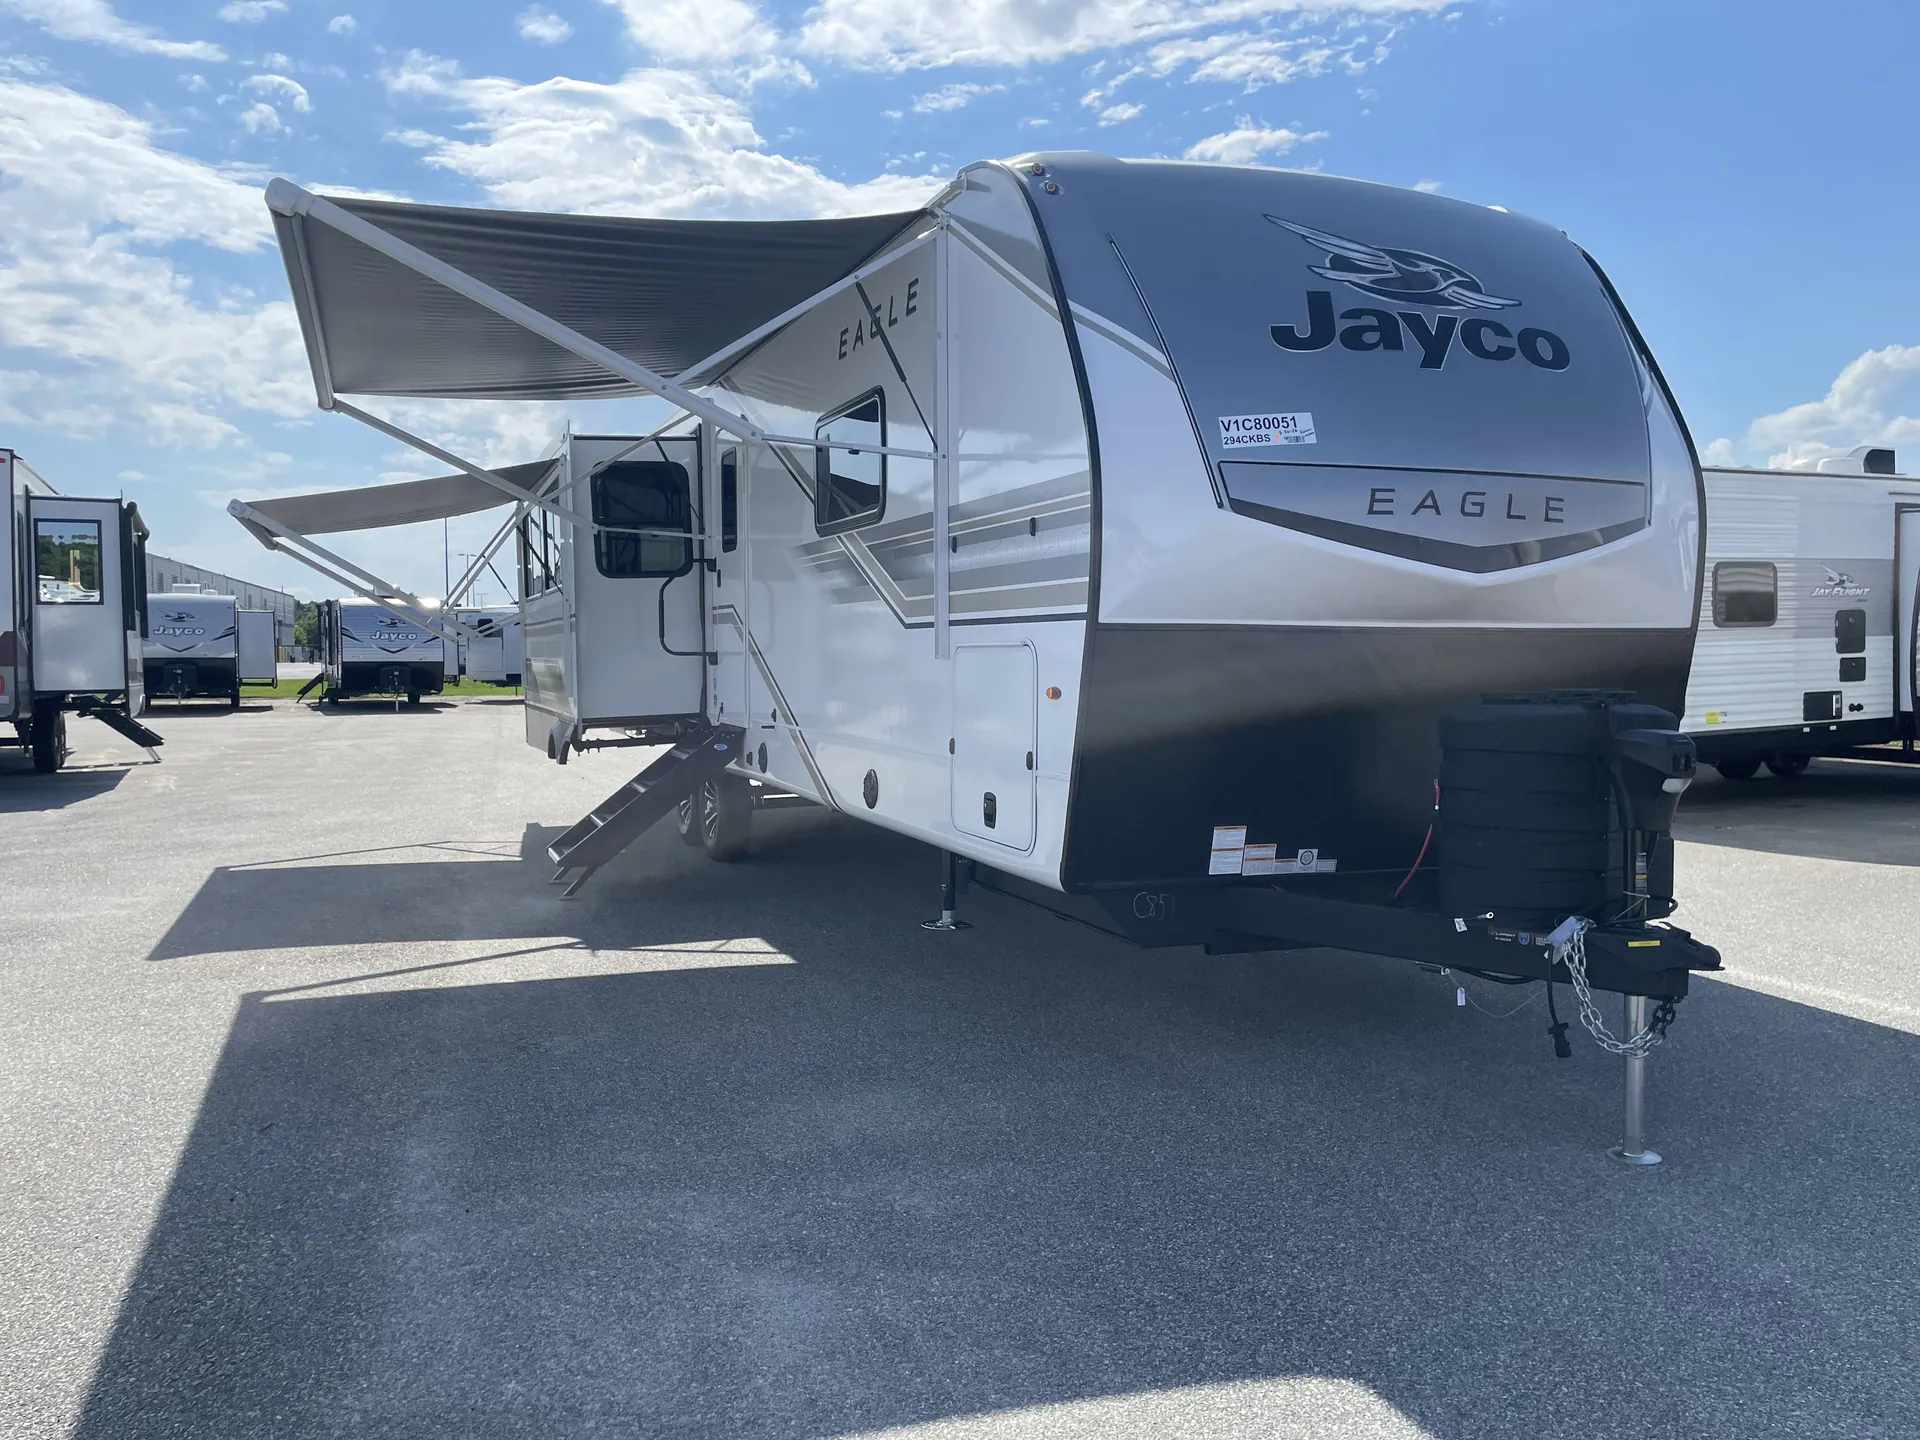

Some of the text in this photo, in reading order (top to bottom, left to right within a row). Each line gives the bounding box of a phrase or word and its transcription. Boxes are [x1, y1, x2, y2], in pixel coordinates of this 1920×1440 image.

[1269, 290, 1571, 372] Jayco
[1220, 416, 1297, 432] V1C80051
[1223, 434, 1271, 445] 294CKBS
[1367, 488, 1564, 523] EAGLE
[1811, 587, 1871, 597] JAY FLIGHT
[153, 625, 205, 636] Jayco
[370, 630, 417, 642] Jayco
